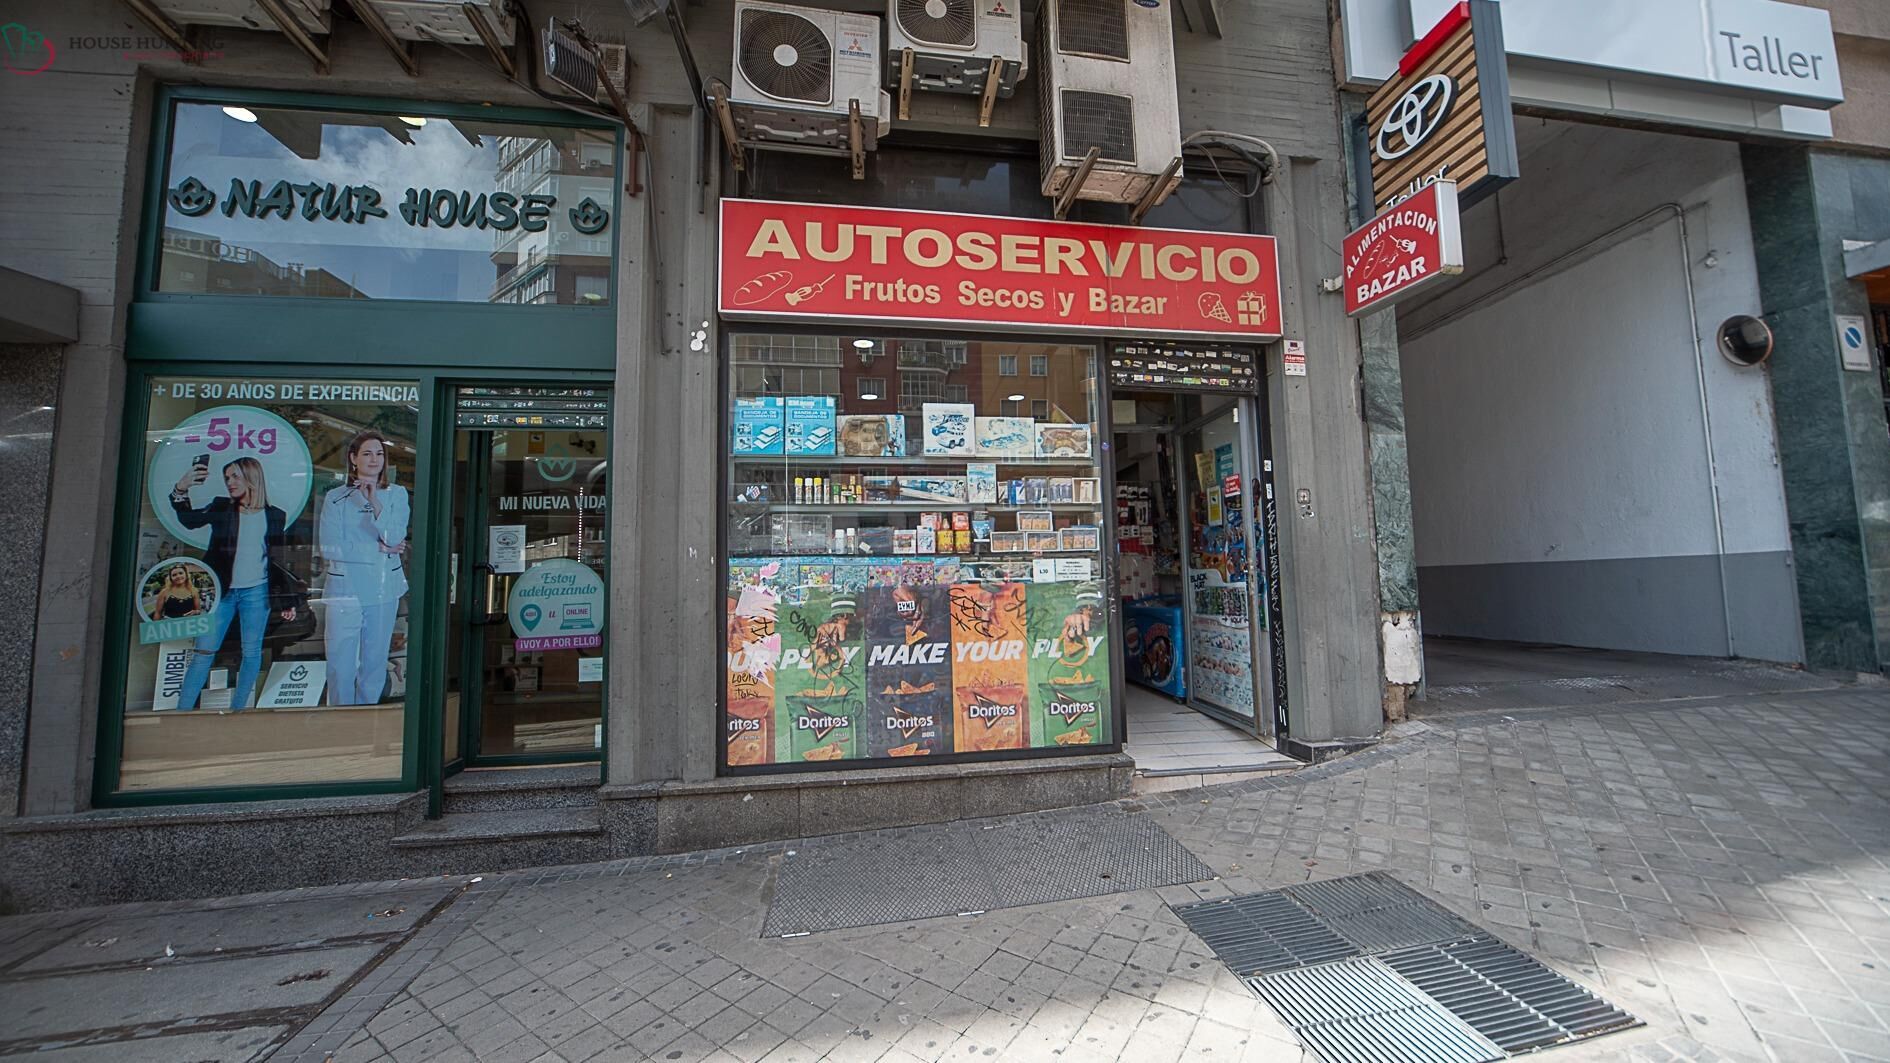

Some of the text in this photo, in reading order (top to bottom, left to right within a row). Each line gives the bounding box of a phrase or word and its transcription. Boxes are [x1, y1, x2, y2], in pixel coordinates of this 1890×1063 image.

[1719, 31, 1822, 80] Taller
[221, 178, 557, 232] NATUR HOUSE
[745, 219, 1260, 284] AUTOSERVICIO
[1346, 210, 1437, 279] ALIMENTACION
[1357, 256, 1427, 303] BAZAR
[845, 274, 1168, 317] Frutos Secos y Bazar
[154, 381, 419, 401] + DE 30 AÑOS DE EXPERIENCIA
[238, 423, 277, 454] kg
[500, 496, 607, 510] MI NUEVA VIDA
[541, 572, 577, 586] Estoy
[518, 584, 597, 599] adelgazando
[566, 608, 588, 616] ONLINE
[145, 618, 209, 641] ANTES
[544, 639, 550, 648] A
[553, 638, 571, 647] POR
[573, 636, 598, 646] ELLO!
[955, 640, 1024, 662] YOUR
[868, 643, 950, 666] MAKE
[163, 650, 186, 698] SLIMBEL
[970, 704, 1016, 718] Doritos
[1050, 701, 1095, 715] Doritos
[728, 718, 760, 730] ritos
[799, 715, 849, 730] Doritos
[887, 715, 933, 730] Doritos
